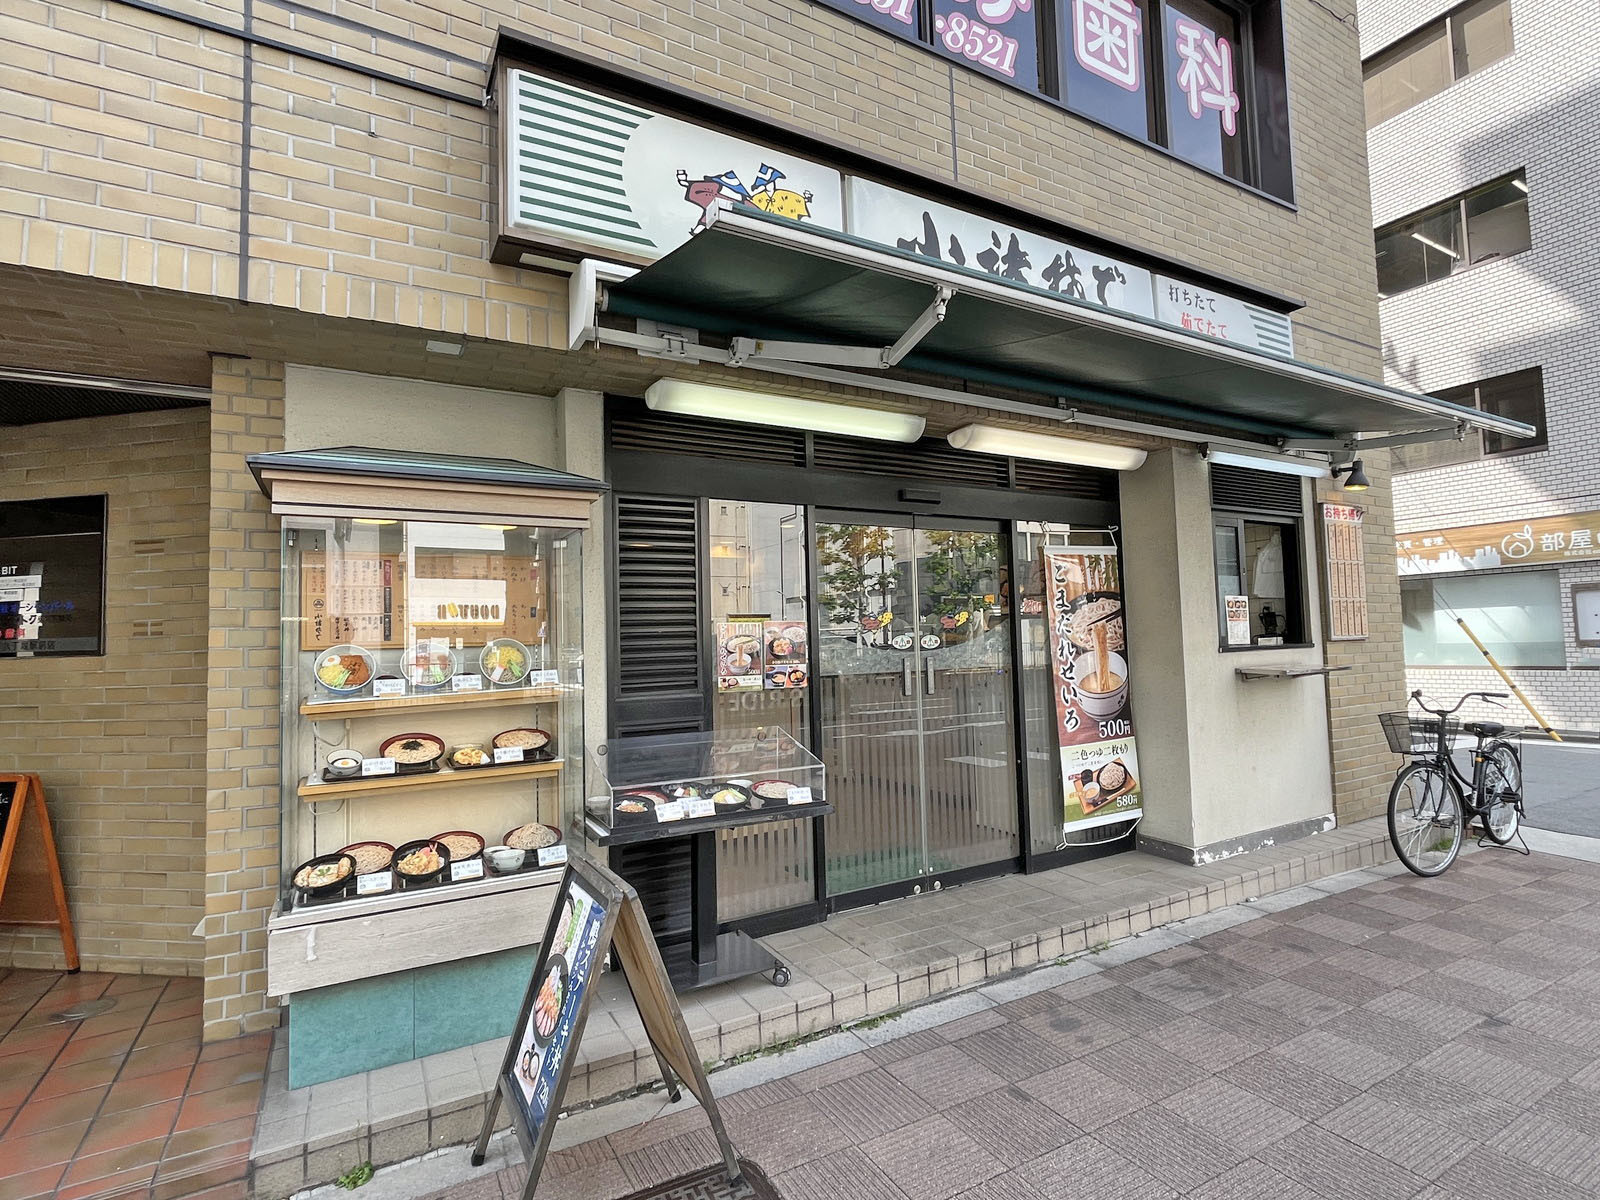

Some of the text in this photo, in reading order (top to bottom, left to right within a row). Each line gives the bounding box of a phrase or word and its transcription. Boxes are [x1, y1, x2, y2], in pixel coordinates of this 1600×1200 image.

[1169, 284, 1216, 313] 打ちたて
[1539, 529, 1600, 551] 部屋
[1, 566, 18, 575] BIT
[1054, 563, 1080, 732] ごまだれせいろ
[1098, 718, 1131, 739] 500円
[1071, 743, 1129, 761] 二色つゆ二枚もり
[1116, 793, 1138, 808] 580円
